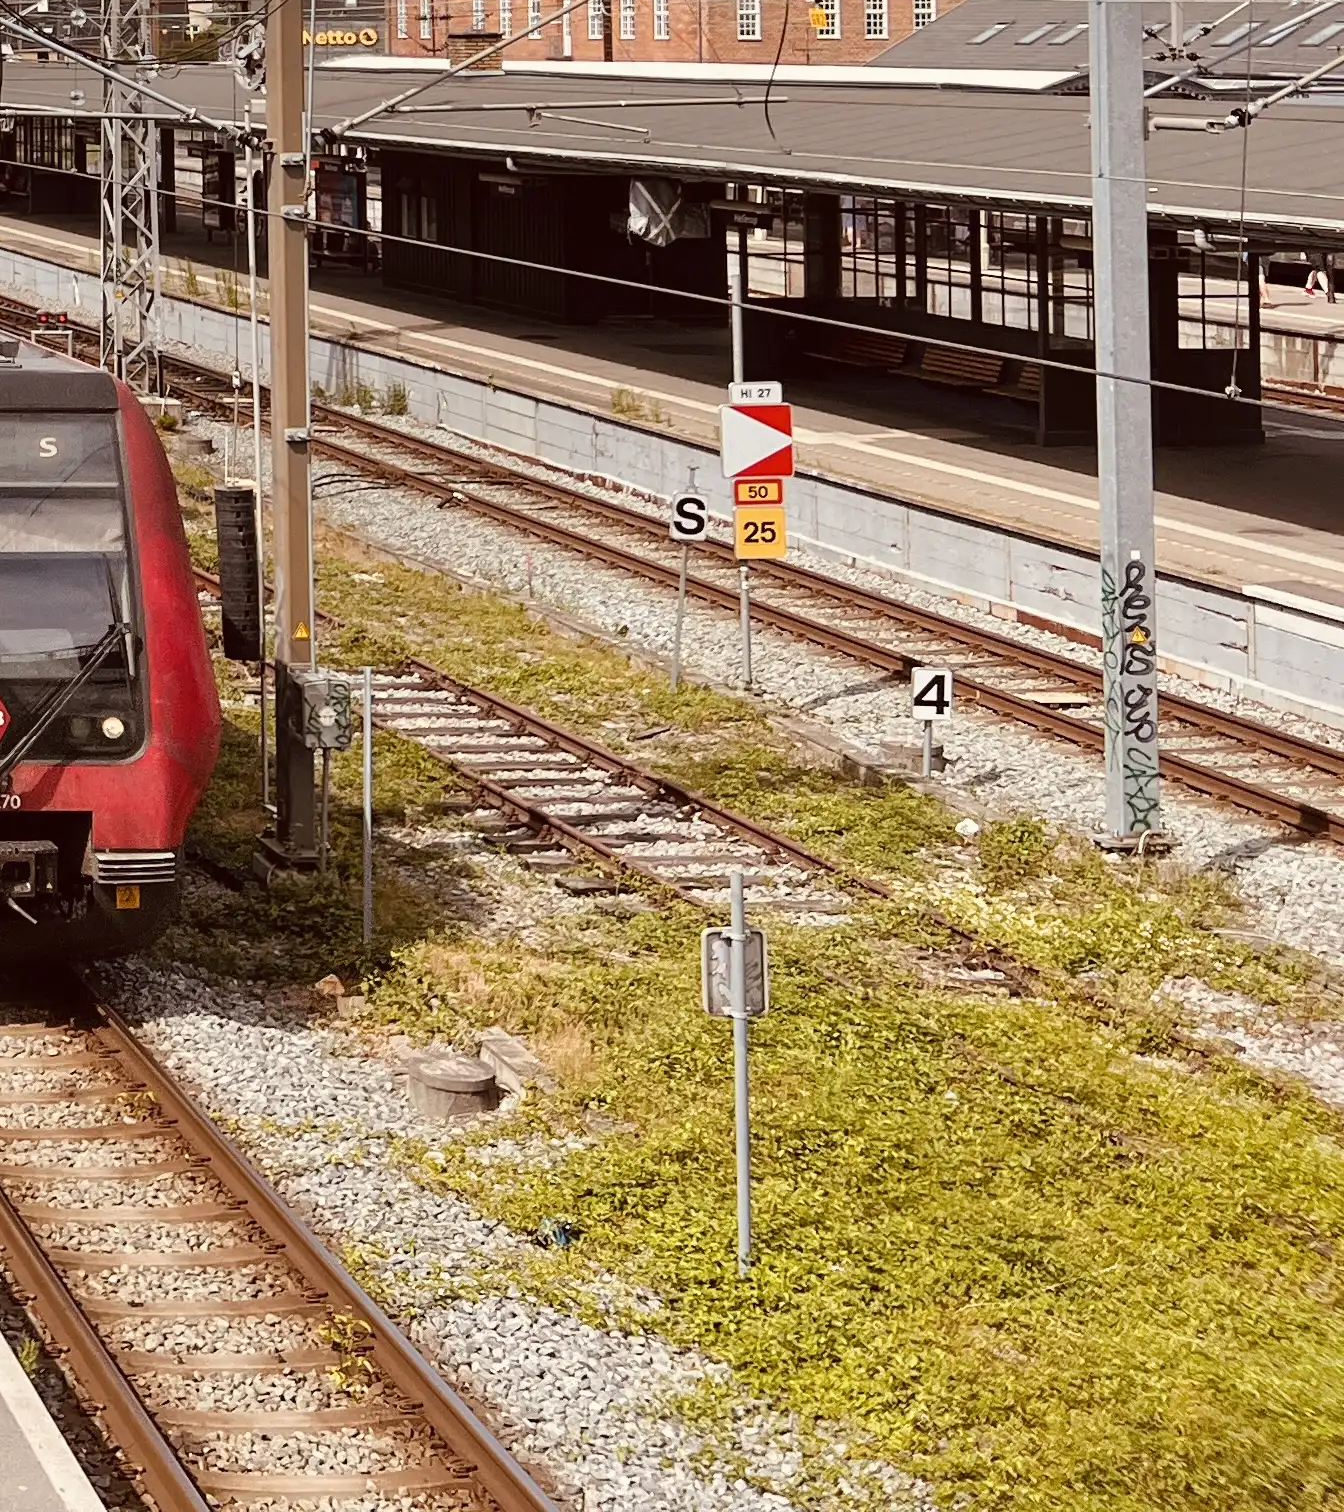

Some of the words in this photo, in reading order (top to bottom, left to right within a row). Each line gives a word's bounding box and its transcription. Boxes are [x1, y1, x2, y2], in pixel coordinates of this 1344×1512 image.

[302, 30, 357, 45] Netto
[757, 389, 771, 398] 27
[39, 437, 58, 458] S
[747, 486, 769, 499] 50
[673, 497, 706, 535] S
[743, 521, 777, 543] 25
[913, 674, 950, 715] 4
